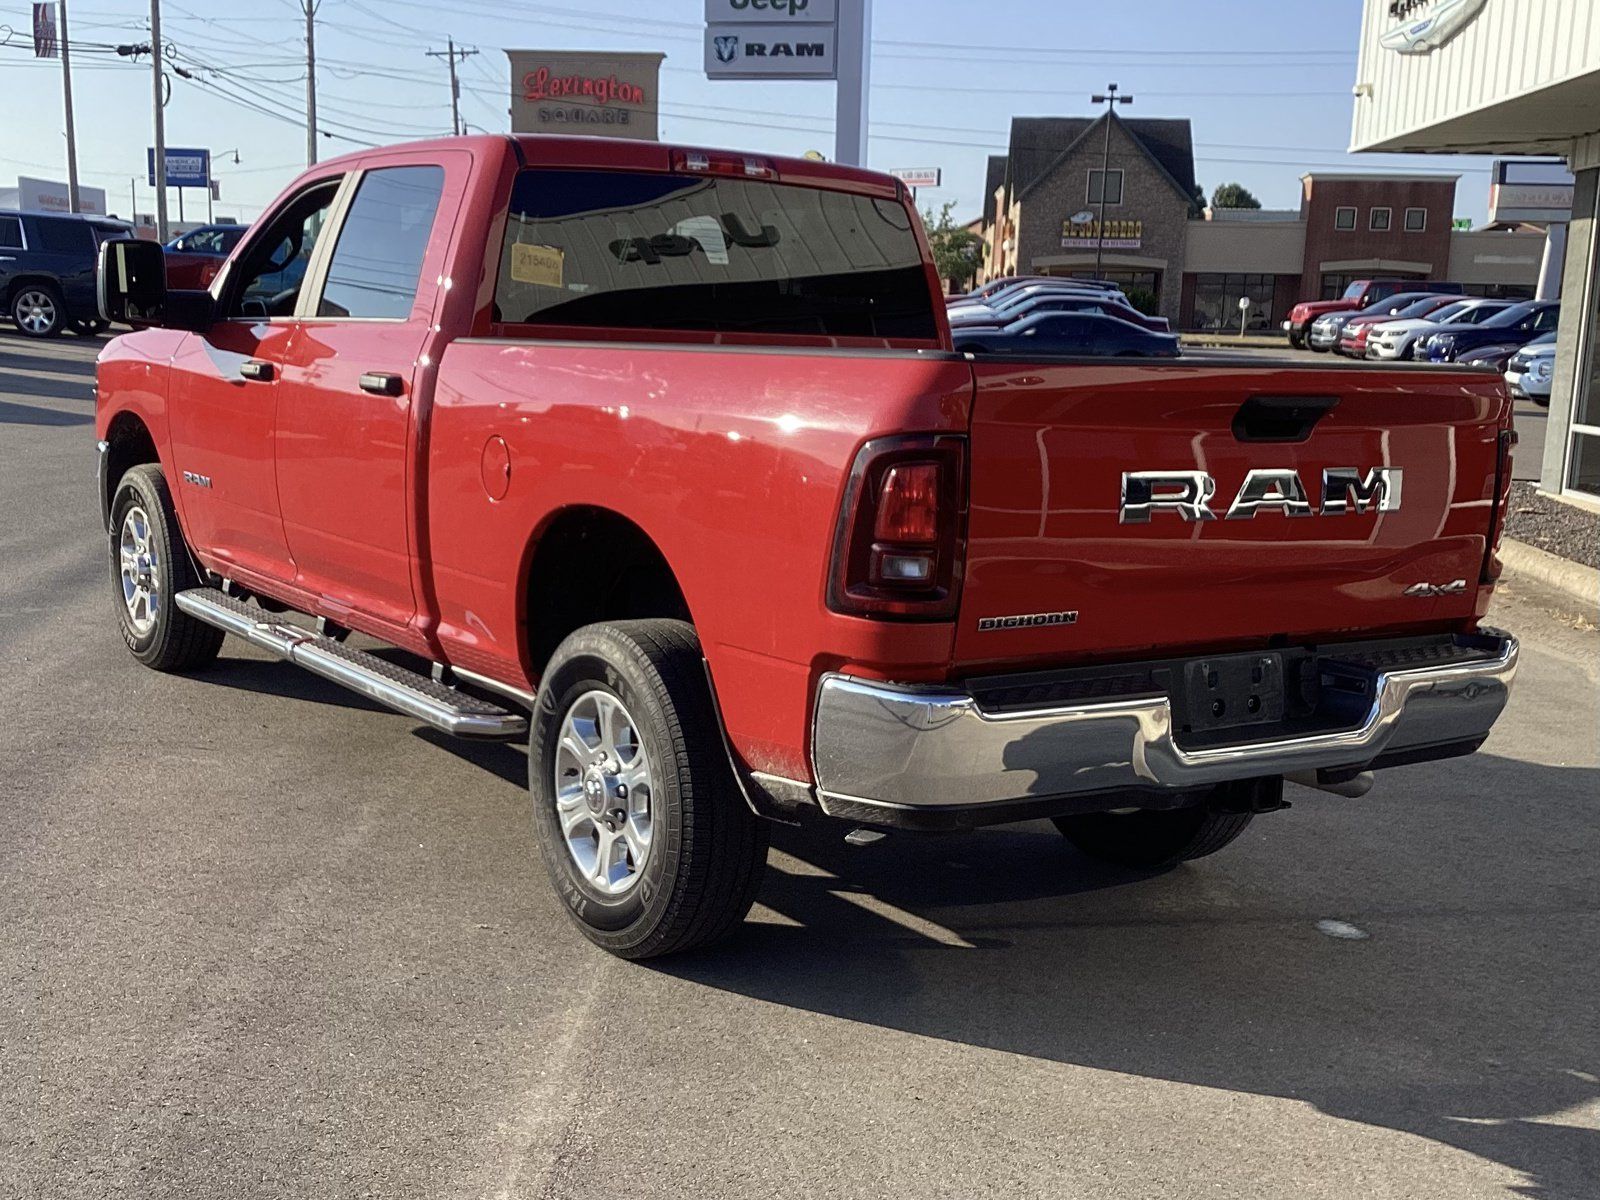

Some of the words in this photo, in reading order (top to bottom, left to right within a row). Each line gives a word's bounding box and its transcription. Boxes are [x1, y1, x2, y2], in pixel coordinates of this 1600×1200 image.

[745, 43, 824, 57] RAM
[522, 66, 643, 105] Lexington
[538, 107, 629, 125] SQUARE
[183, 470, 213, 489] RAM
[1119, 467, 1403, 524] RAM
[978, 611, 1079, 632] BIGHORN
